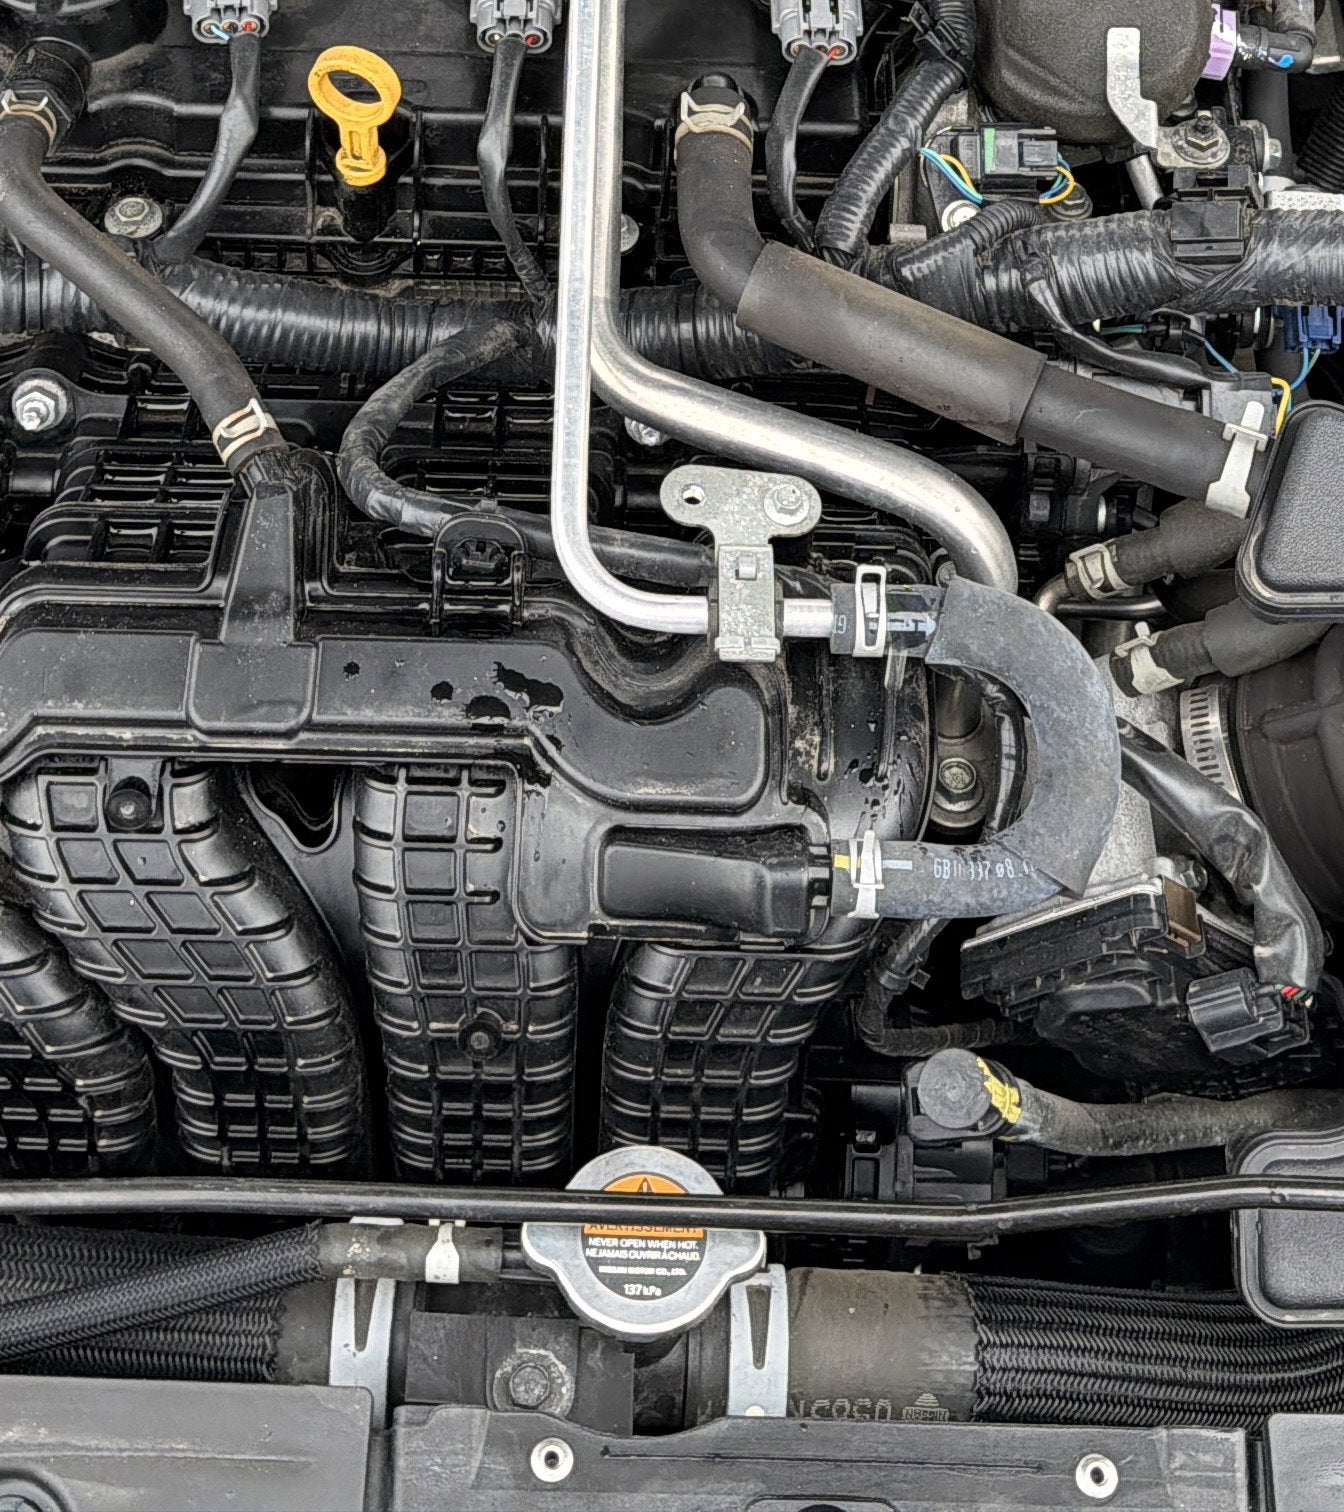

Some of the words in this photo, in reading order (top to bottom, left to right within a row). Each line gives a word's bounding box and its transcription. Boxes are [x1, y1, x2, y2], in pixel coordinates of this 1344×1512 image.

[588, 1237, 619, 1248] NEVER
[619, 1238, 647, 1249] OPEN
[647, 1239, 676, 1249] WHEN
[677, 1240, 699, 1250] HOT.
[624, 1284, 642, 1296] 137
[642, 1284, 662, 1296] kPa
